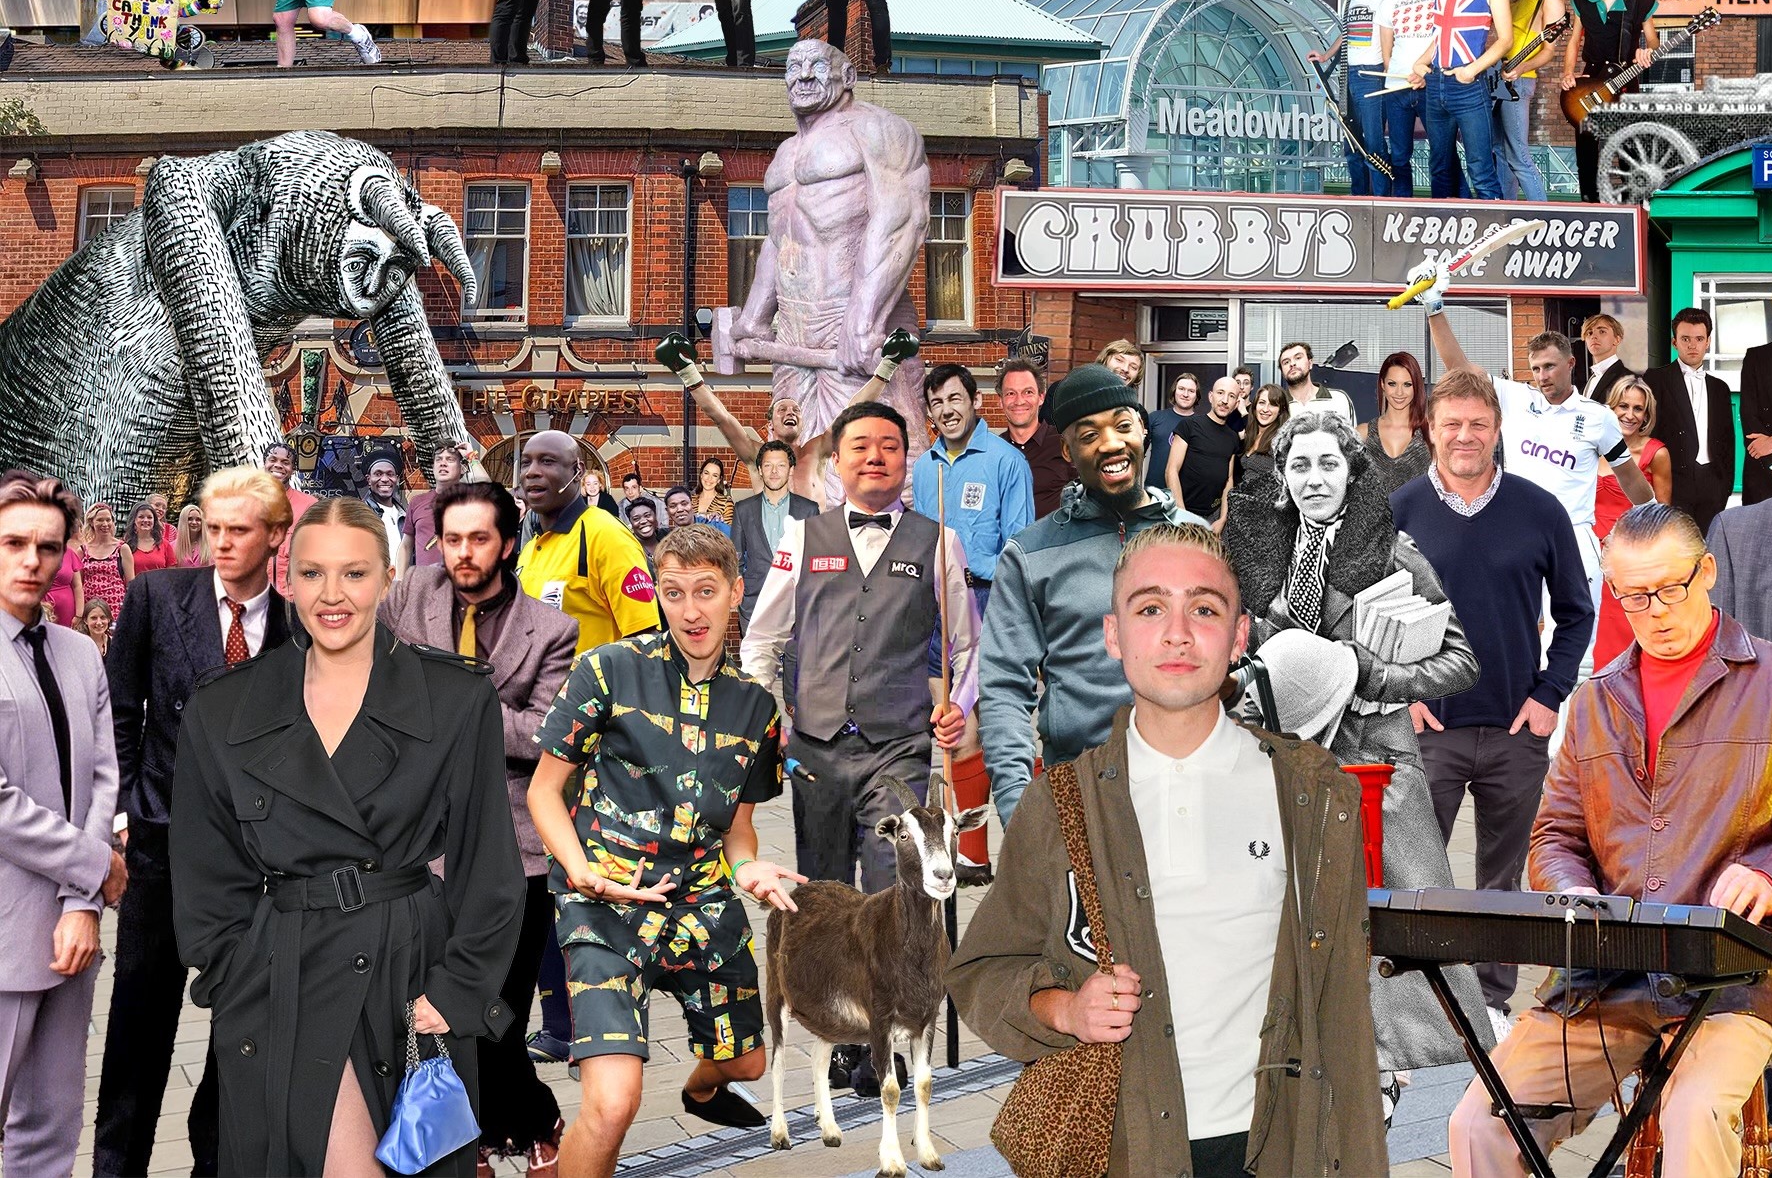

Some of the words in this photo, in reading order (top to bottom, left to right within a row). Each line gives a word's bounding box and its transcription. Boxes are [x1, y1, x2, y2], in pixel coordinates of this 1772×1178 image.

[121, 11, 168, 29] THANK
[128, 24, 154, 40] YOU
[1015, 201, 1357, 280] CHUBBYS
[1382, 212, 1478, 244] KEBAB
[1503, 249, 1582, 279] AWAY
[521, 384, 640, 414] GRAPES
[1520, 439, 1577, 470] cinch
